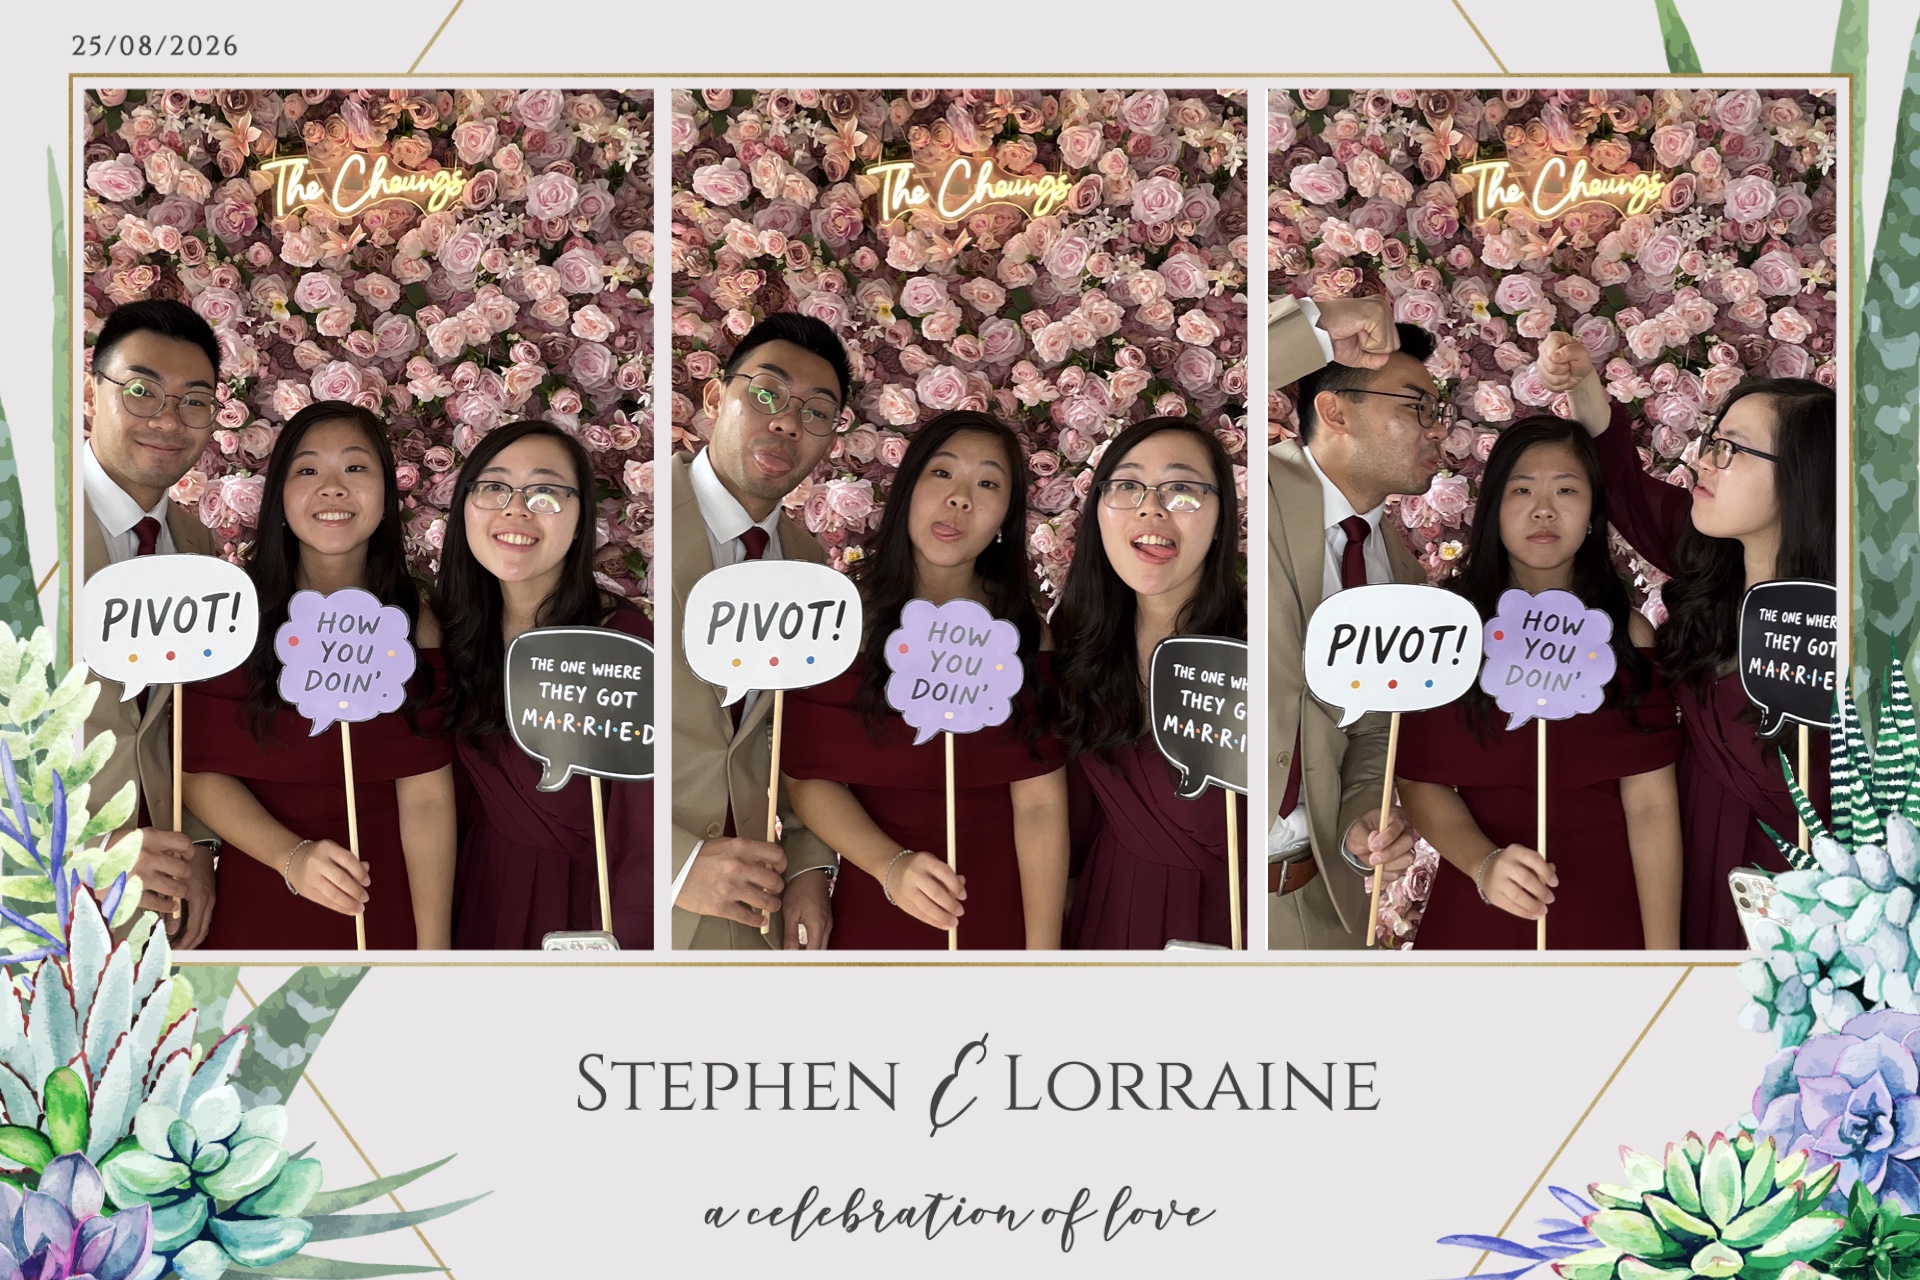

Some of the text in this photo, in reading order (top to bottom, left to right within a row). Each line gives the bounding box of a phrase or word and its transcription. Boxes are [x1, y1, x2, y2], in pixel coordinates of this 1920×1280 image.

[261, 157, 324, 216] The
[866, 162, 930, 221] The
[1461, 161, 1525, 219] The
[102, 591, 241, 643] PIVOT!
[317, 611, 381, 635] HOW
[706, 600, 846, 645] PIVOT!
[1521, 609, 1585, 636] HOW
[1759, 608, 1778, 623] THE
[1781, 611, 1803, 625] ONE
[927, 621, 992, 648] HOW
[1326, 623, 1468, 667] PIVOT!
[1764, 631, 1837, 658] THEY GOT
[321, 640, 374, 665] YOU
[930, 650, 983, 676] YOU
[1524, 636, 1577, 665] YOU
[304, 669, 382, 694] DOIN'
[530, 657, 642, 681] THE ONE WHERE
[1173, 663, 1196, 681] THE
[1200, 670, 1226, 686] ONE
[1505, 664, 1582, 693] DOIN'
[538, 681, 638, 709] THEY GOT
[910, 678, 989, 706] DOIN'
[1180, 689, 1226, 716] THEY
